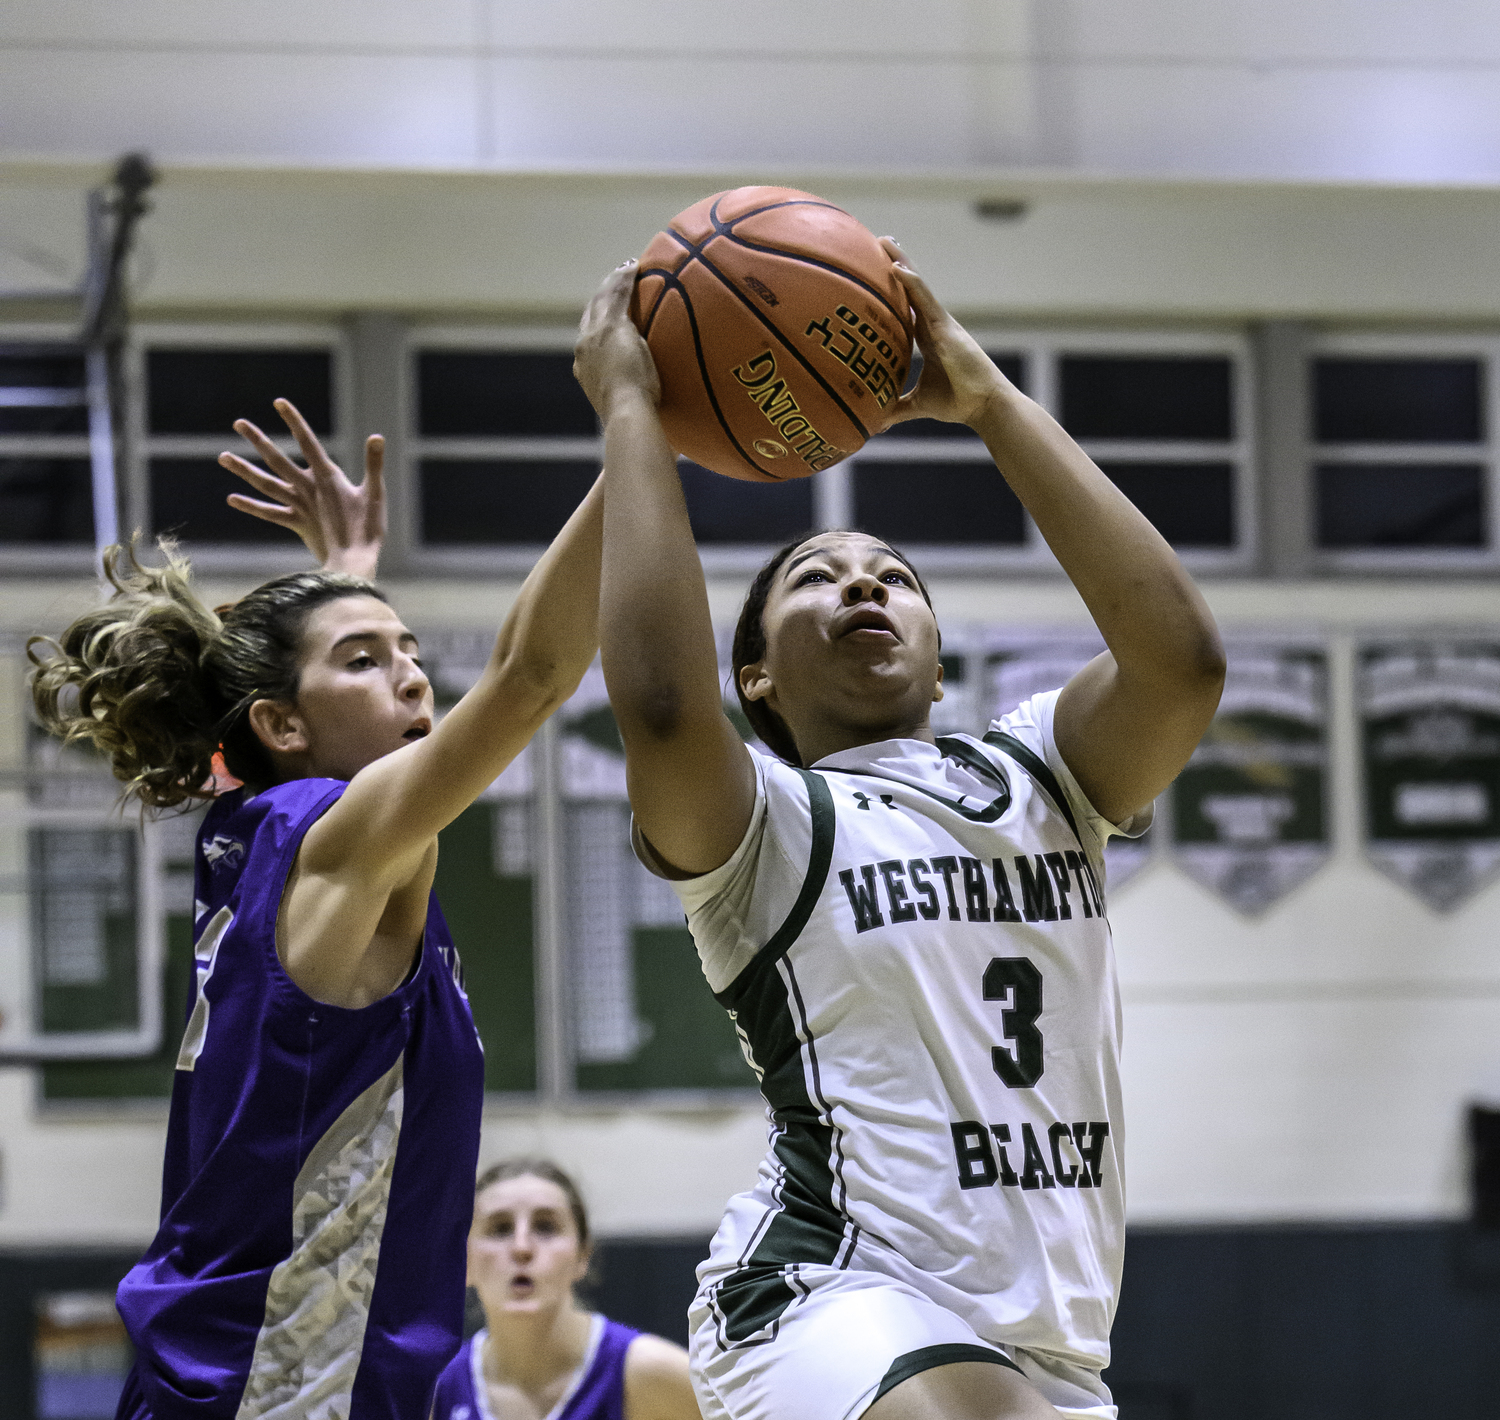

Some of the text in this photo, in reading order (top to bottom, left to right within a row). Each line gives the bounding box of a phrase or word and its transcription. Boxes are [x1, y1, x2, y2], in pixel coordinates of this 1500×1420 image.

[804, 316, 899, 410] EGACY
[730, 349, 846, 472] PALDING
[838, 849, 1106, 934] WESTHAMPTO
[982, 957, 1044, 1088] 3
[950, 1121, 1109, 1191] BEACH
